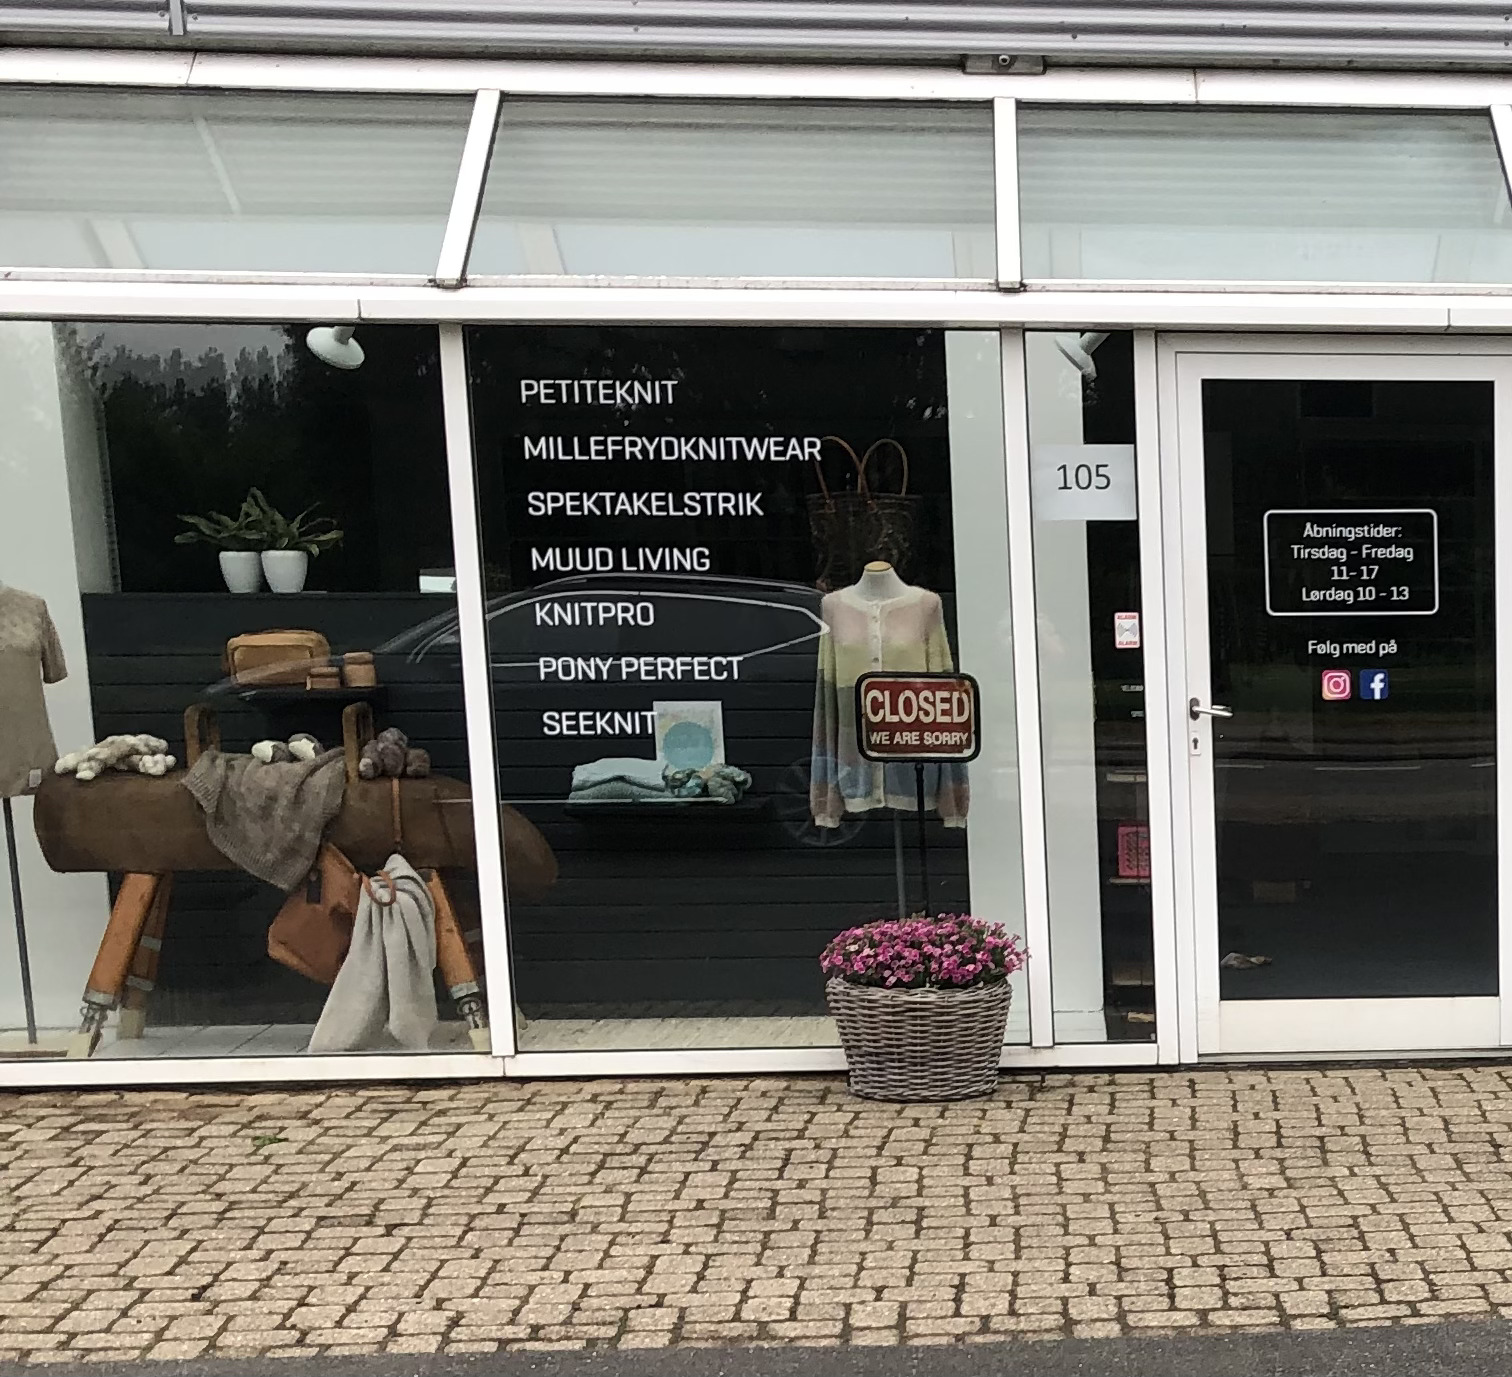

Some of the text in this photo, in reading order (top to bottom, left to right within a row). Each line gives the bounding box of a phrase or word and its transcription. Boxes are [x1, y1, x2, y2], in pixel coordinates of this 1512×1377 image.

[520, 379, 679, 404] PETITEKNIT
[523, 436, 822, 461] MILLEFRYDKNITWEAR
[1056, 463, 1111, 490] 105
[527, 491, 764, 516] SPEKTAKELSTRIK
[1302, 521, 1403, 541] Åbningstider:
[530, 547, 711, 572] MUUD LIVING
[1290, 544, 1348, 562] Tirsdag
[1361, 543, 1414, 562] Fredag
[1301, 586, 1354, 604] Lørdag
[1356, 586, 1376, 601] 10
[1389, 586, 1410, 600] 13
[535, 602, 656, 627] KNITPRO
[1307, 639, 1398, 657] Følg med på
[538, 656, 744, 681] PONY PERFECT
[865, 689, 971, 723] CLOSED
[541, 711, 658, 736] SEEKNIT
[869, 731, 969, 746] WE ARE SORRY
